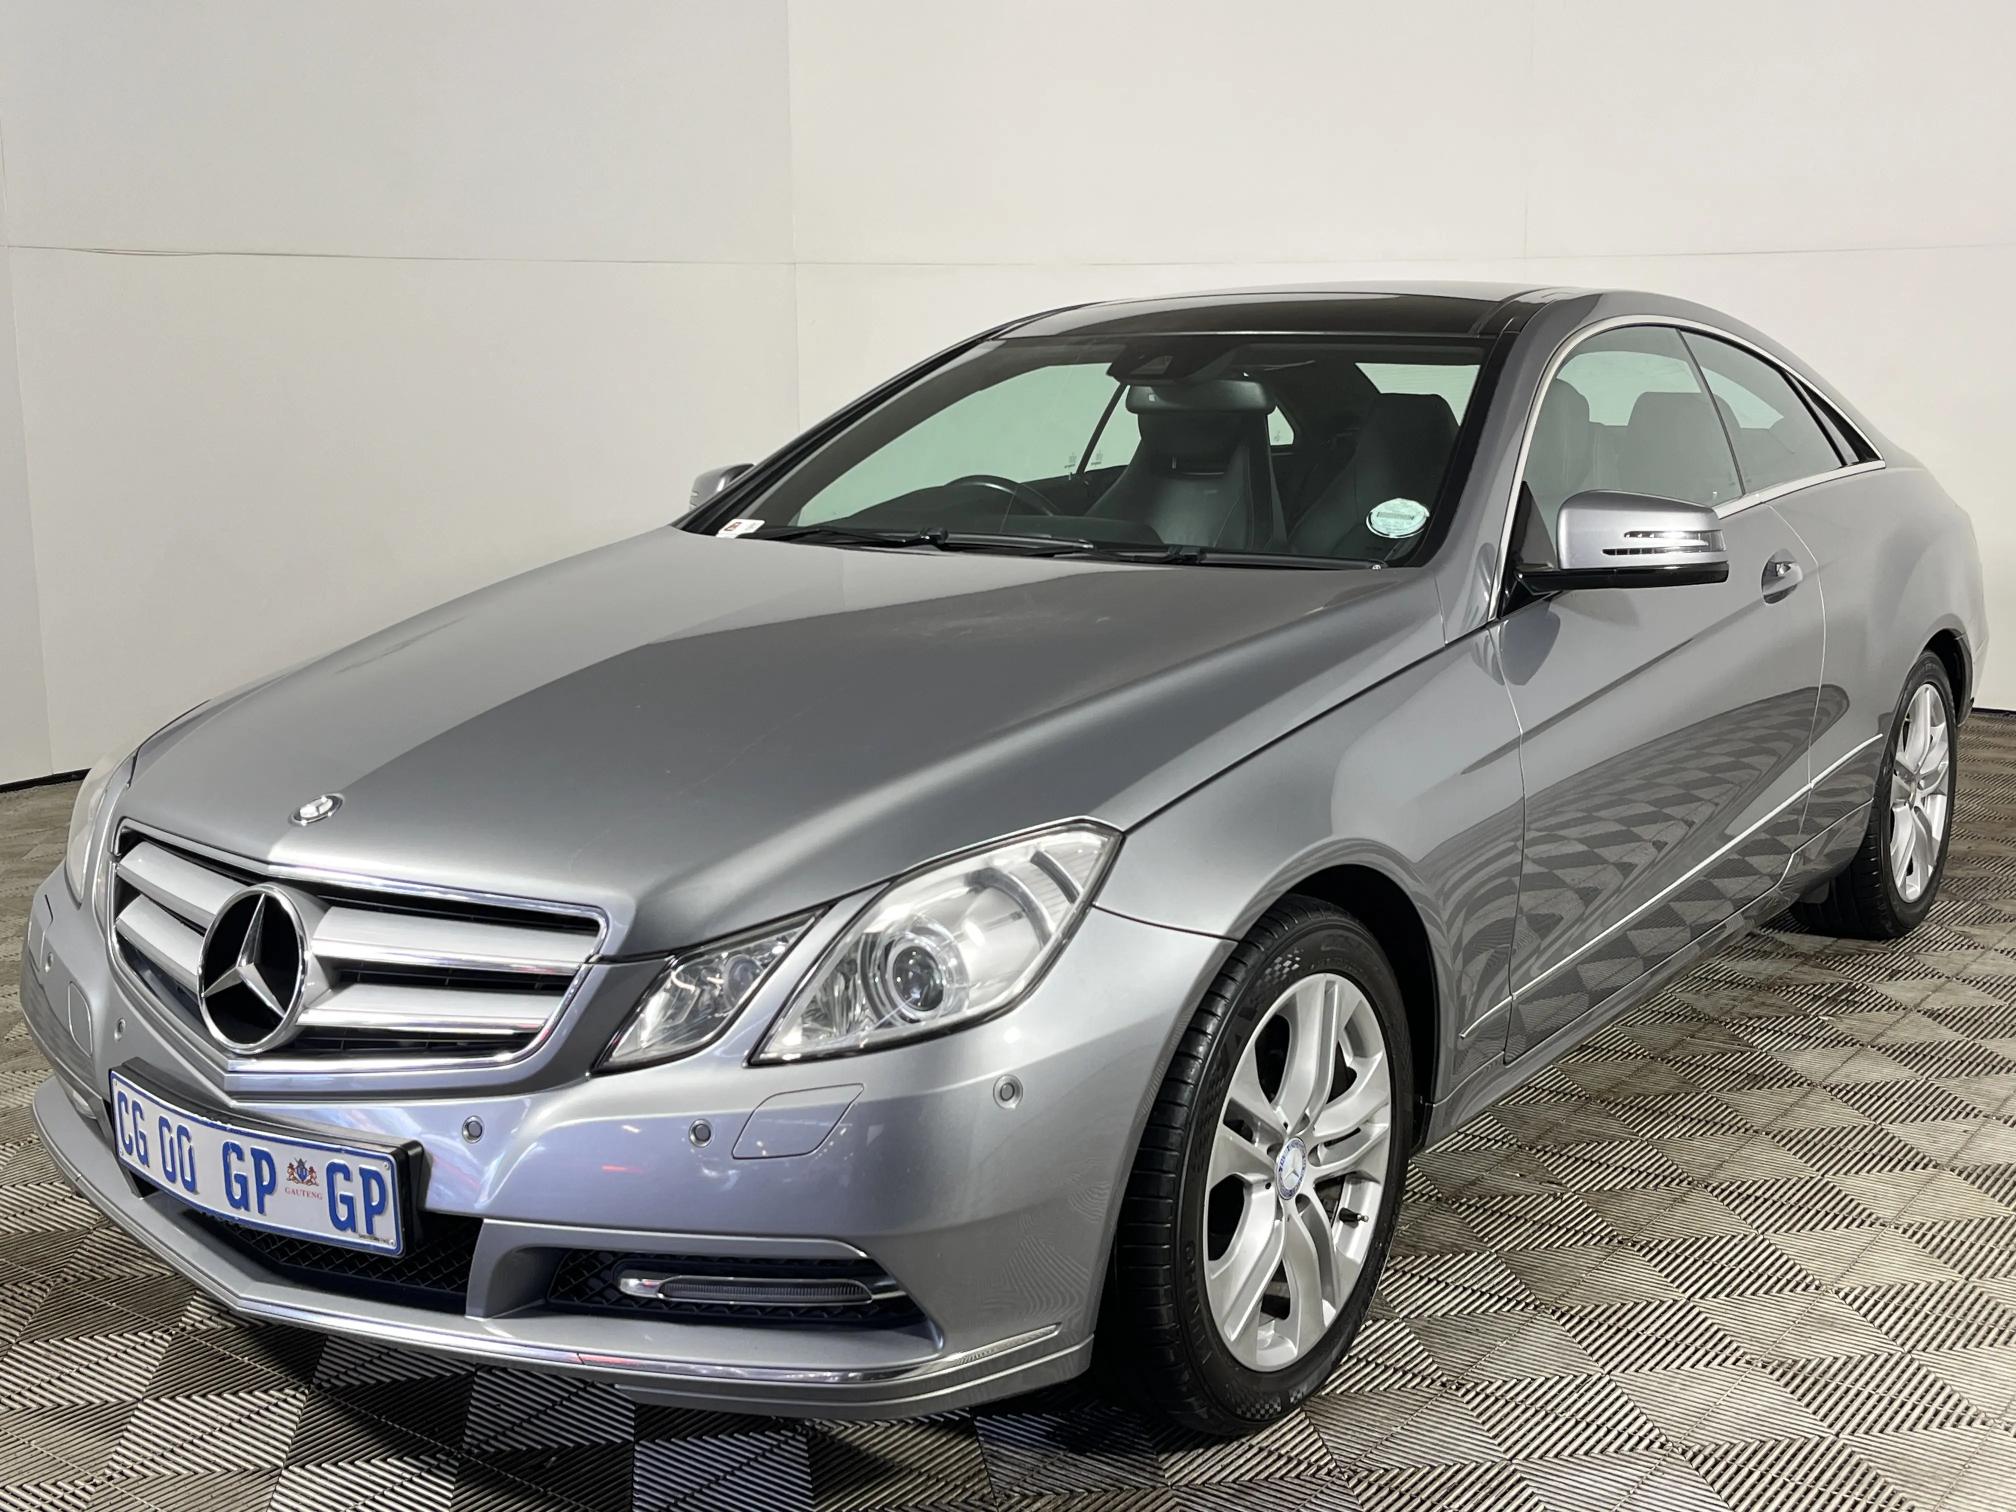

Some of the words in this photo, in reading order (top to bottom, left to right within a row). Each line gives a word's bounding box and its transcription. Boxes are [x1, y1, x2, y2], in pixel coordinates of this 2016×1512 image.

[117, 1090, 149, 1168] CG
[222, 1140, 276, 1214] GP
[326, 1160, 387, 1235] GP
[285, 1187, 323, 1201] GAUTENG
